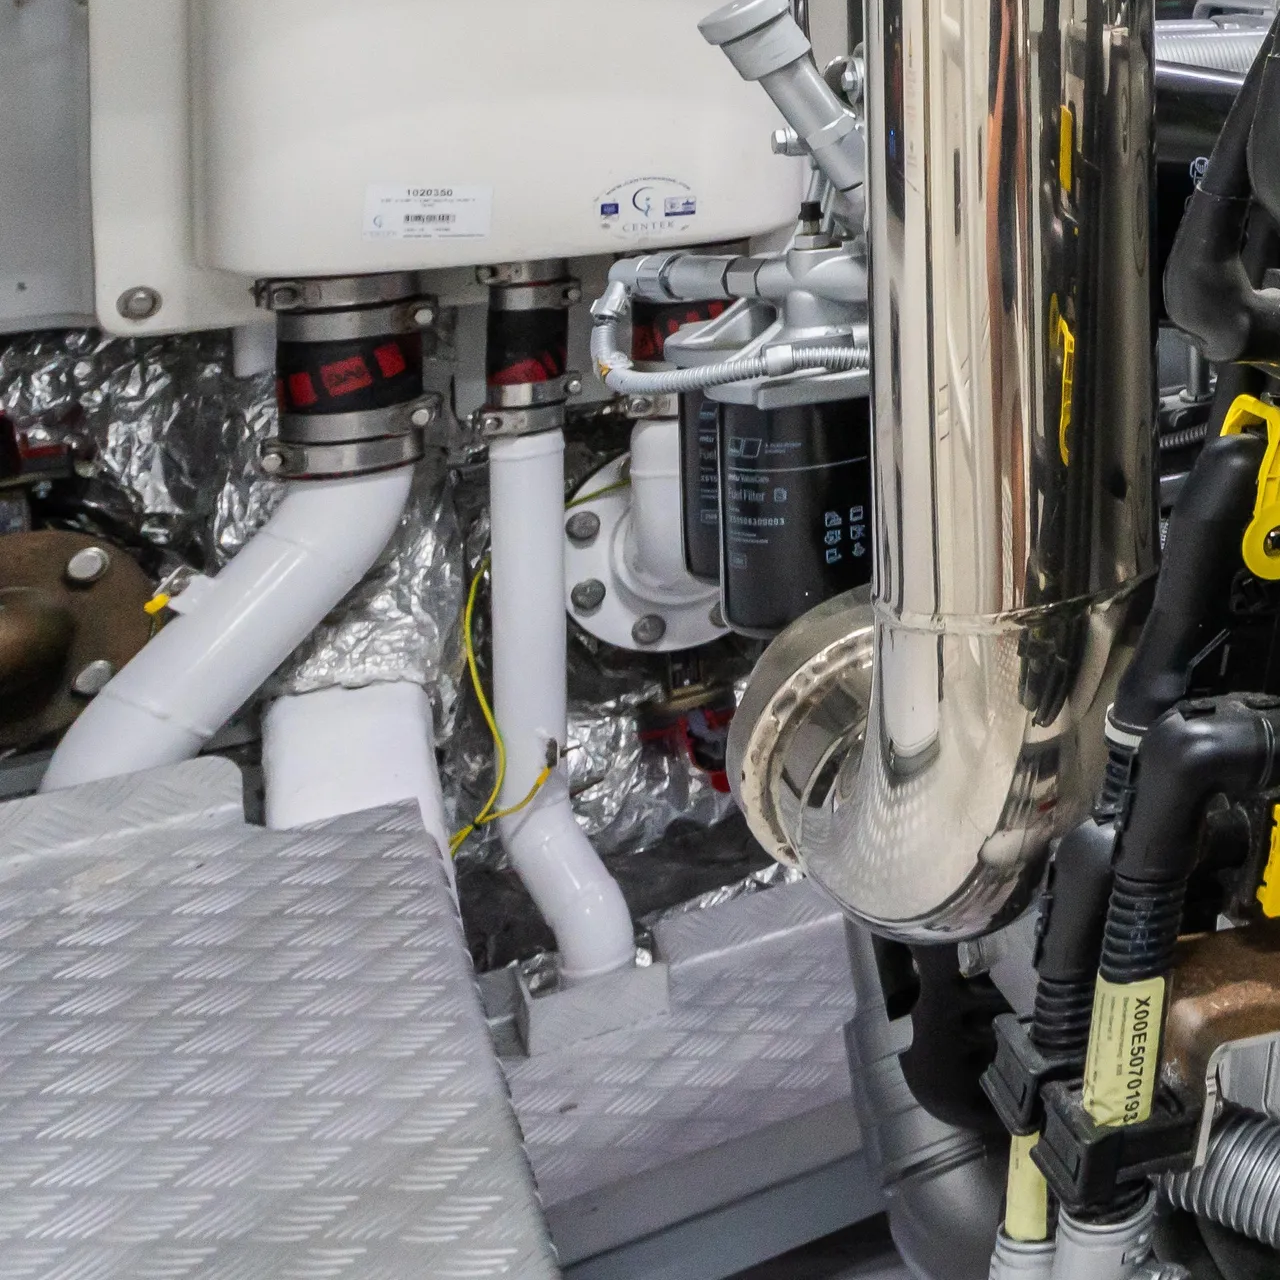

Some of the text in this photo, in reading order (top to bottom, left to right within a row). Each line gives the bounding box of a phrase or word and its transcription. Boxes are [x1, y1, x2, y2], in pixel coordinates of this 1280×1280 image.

[406, 188, 453, 198] 1020350
[622, 221, 676, 232] CENTEK
[728, 486, 766, 502] Fuel Filter
[1122, 995, 1152, 1123] X00E5070193
